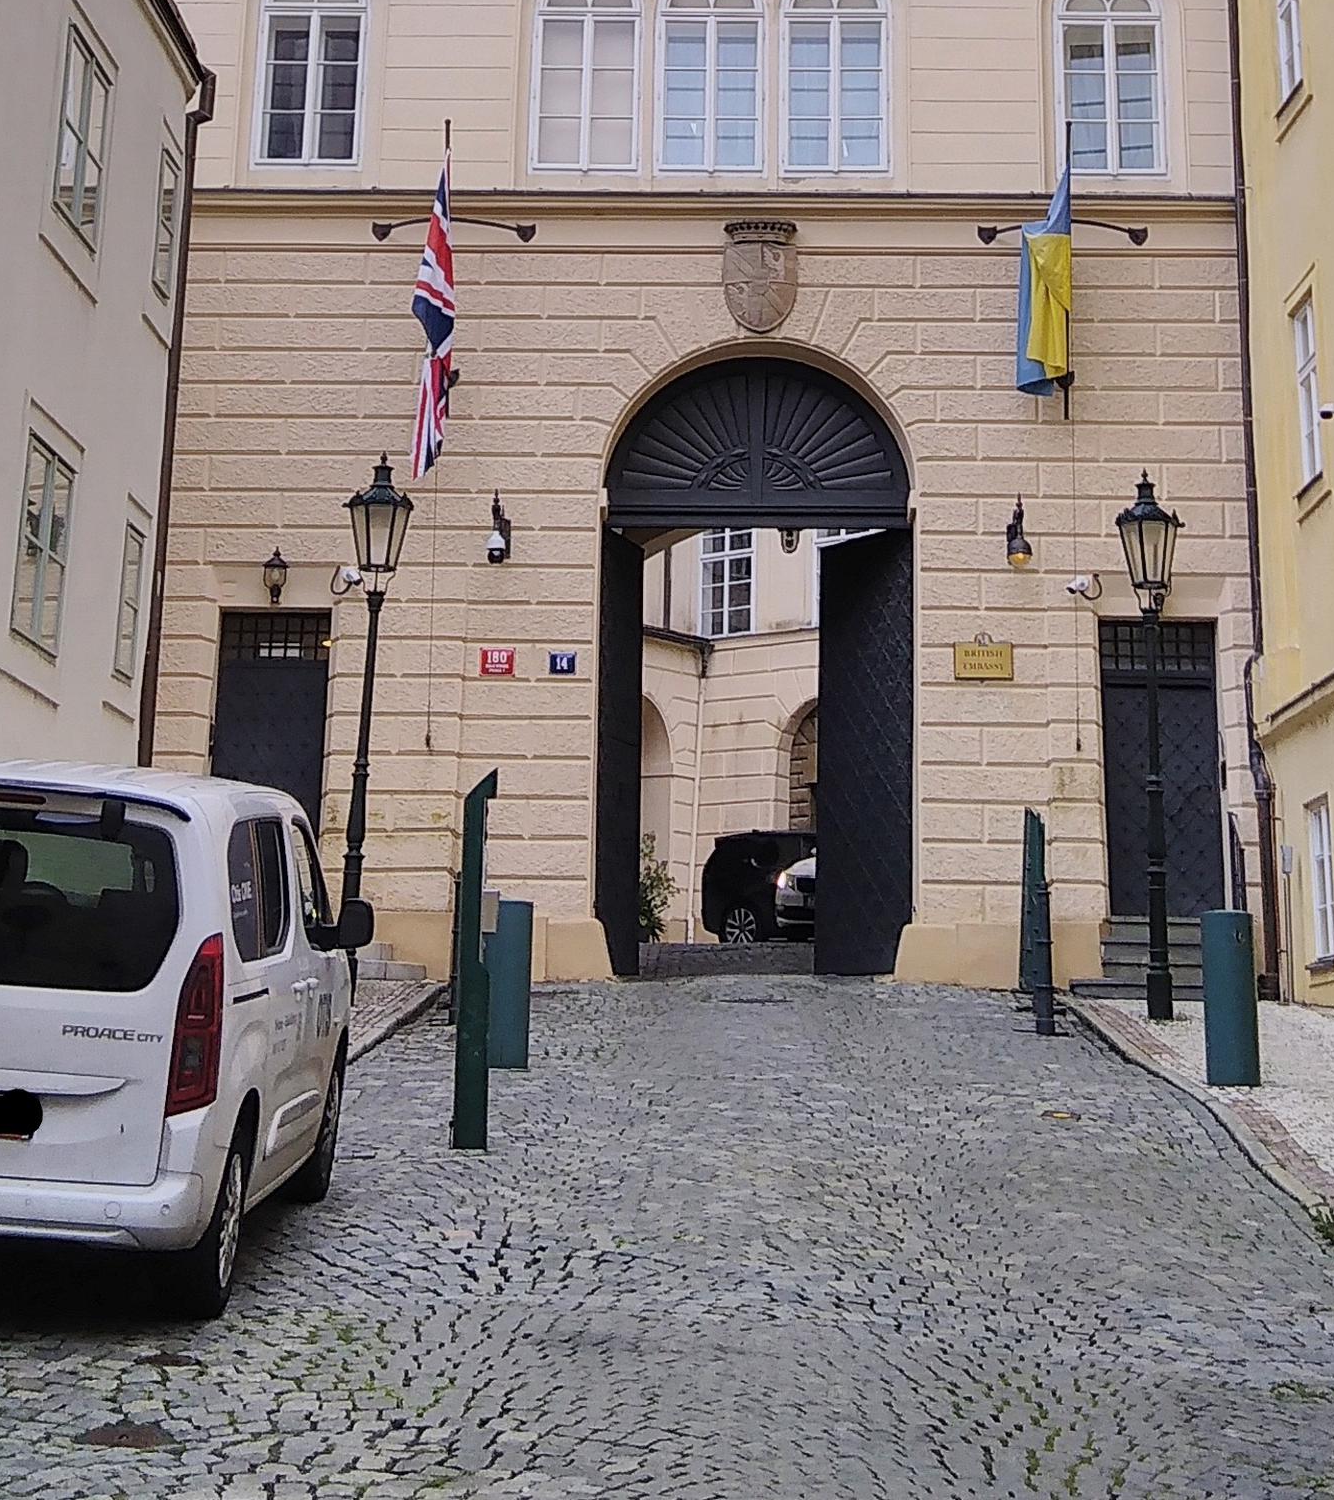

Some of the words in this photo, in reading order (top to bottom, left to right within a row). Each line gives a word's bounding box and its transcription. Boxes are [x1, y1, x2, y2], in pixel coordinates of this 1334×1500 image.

[487, 651, 507, 663] 180
[964, 650, 1003, 658] BRITISH
[556, 657, 568, 670] 14
[962, 662, 1003, 671] EMBASSY
[62, 1025, 135, 1041] PROACE
[137, 1033, 164, 1043] CITY
